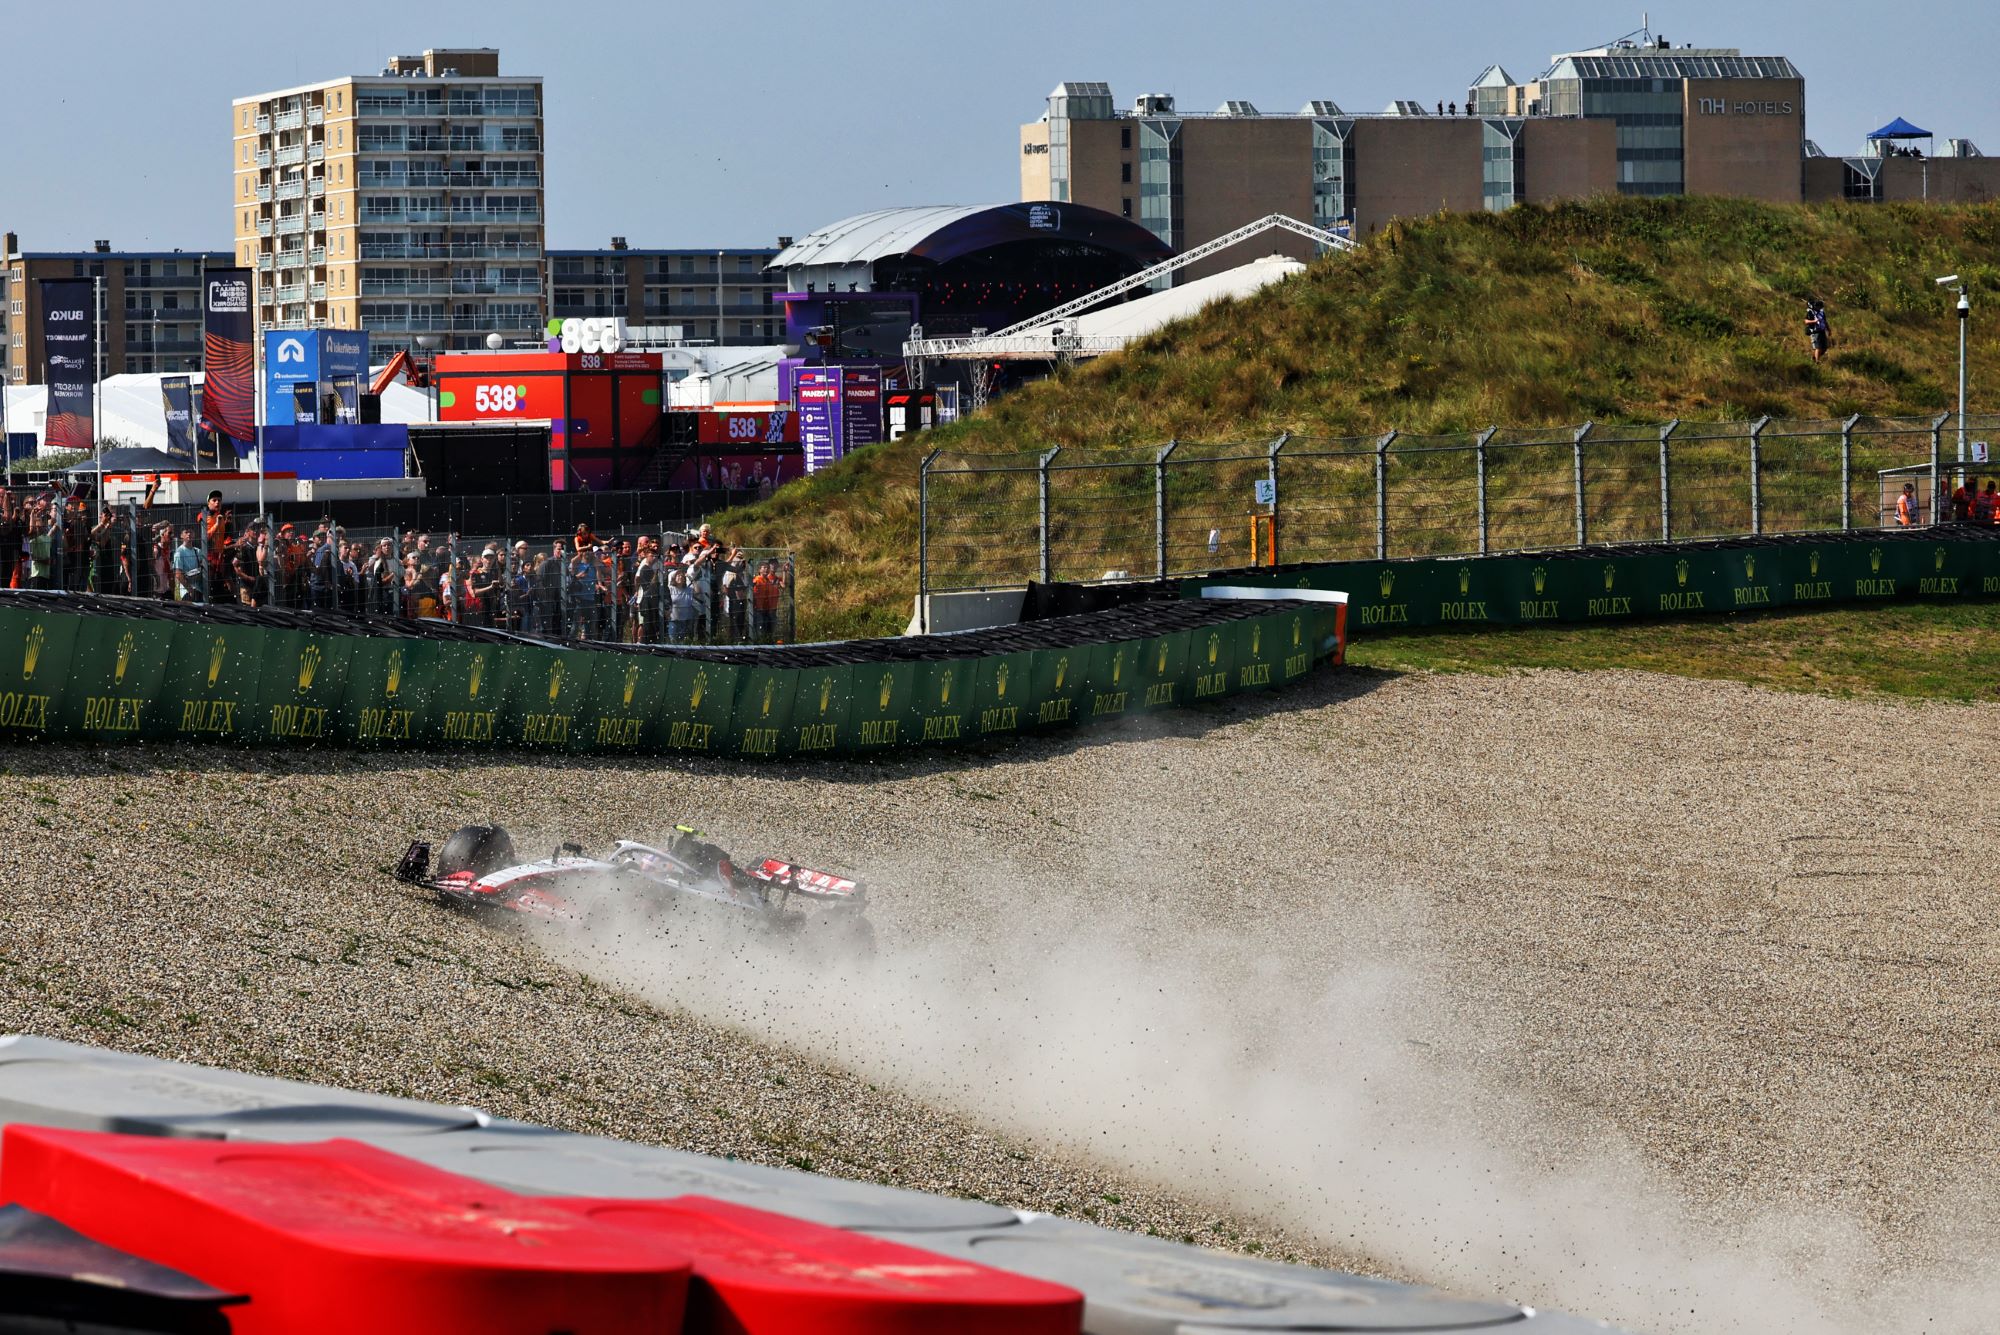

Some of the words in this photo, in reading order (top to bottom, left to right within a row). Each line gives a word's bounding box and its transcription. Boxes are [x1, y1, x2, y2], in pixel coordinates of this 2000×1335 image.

[1733, 101, 1792, 114] HOTELS
[581, 355, 600, 369] 538
[475, 385, 517, 412] 538
[847, 389, 876, 397] FANZONE
[729, 417, 757, 438] 538
[1734, 586, 1770, 605] ROLEX
[1794, 581, 1832, 600] ROLEX
[1856, 579, 1896, 596] ROLEX
[1919, 577, 1958, 594] ROLEX
[1361, 604, 1409, 624] ROLEX
[1441, 601, 1488, 620] ROLEX
[1520, 600, 1559, 619] ROLEX
[1588, 597, 1632, 616] ROLEX
[1660, 591, 1704, 611] ROLEX
[1240, 663, 1270, 687] ROLEX
[1285, 653, 1307, 679] ROLEX
[1144, 682, 1175, 708] ROLEX
[1195, 671, 1227, 698] ROLEX
[0, 691, 50, 729] OLEX
[83, 697, 143, 730] ROLEX
[178, 701, 236, 732] ROLEX
[1038, 698, 1072, 724] ROLEX
[1092, 691, 1128, 717] ROLEX
[270, 704, 326, 737] ROLEX
[358, 709, 415, 739] ROLEX
[443, 711, 496, 741] ROLEX
[522, 714, 571, 743] ROLEX
[596, 717, 644, 745] ROLEX
[861, 720, 899, 745] ROLEX
[922, 715, 961, 741] ROLEX
[981, 706, 1019, 733] ROLEX
[668, 721, 714, 750] ROLEX
[741, 728, 779, 753] ROLEX
[799, 724, 838, 751] ROLEX
